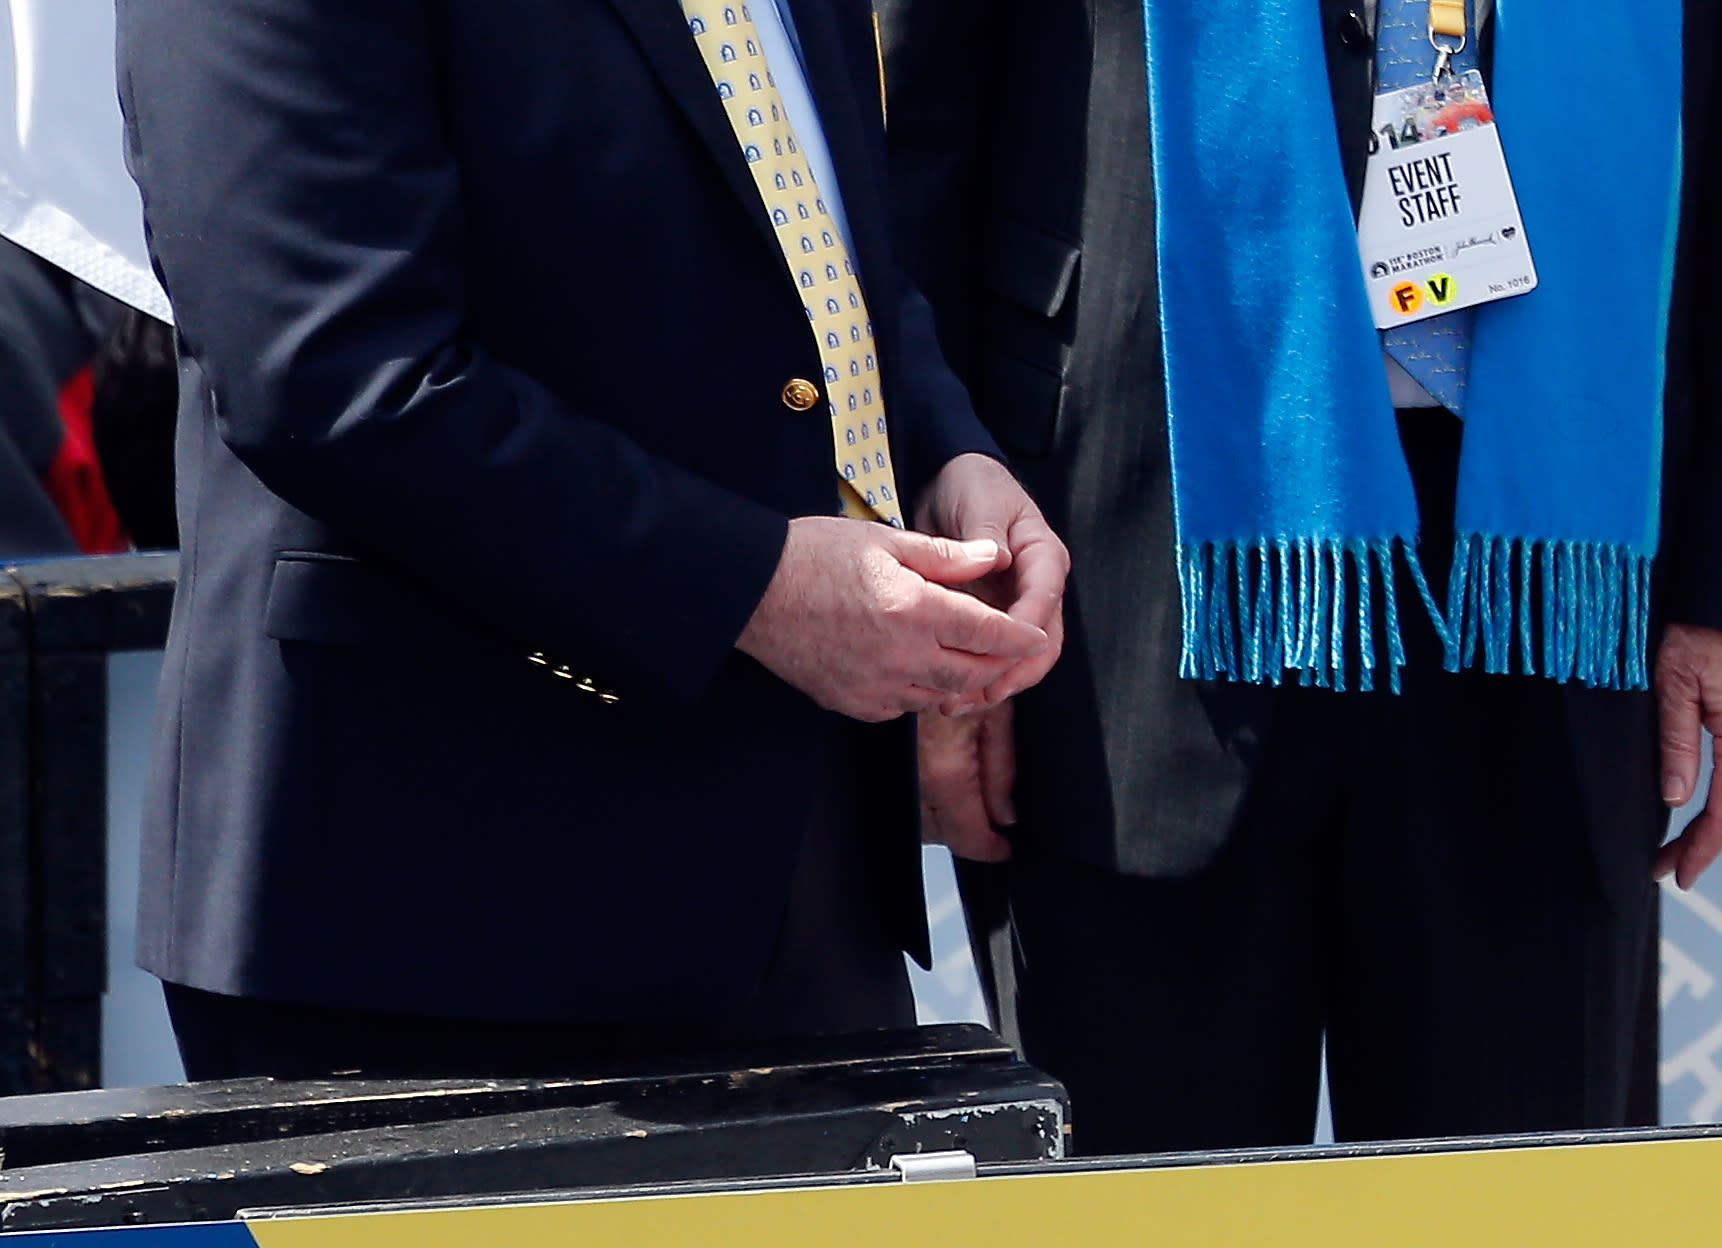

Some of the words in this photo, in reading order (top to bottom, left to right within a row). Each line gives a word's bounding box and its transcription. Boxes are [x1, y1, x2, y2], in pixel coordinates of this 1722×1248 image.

[1388, 152, 1454, 197] EVENT
[1399, 184, 1461, 228] STAFF
[1391, 254, 1444, 273] MARATHON
[1406, 246, 1442, 262] BOSTON
[1395, 286, 1415, 313] F
[1427, 277, 1449, 303] V
